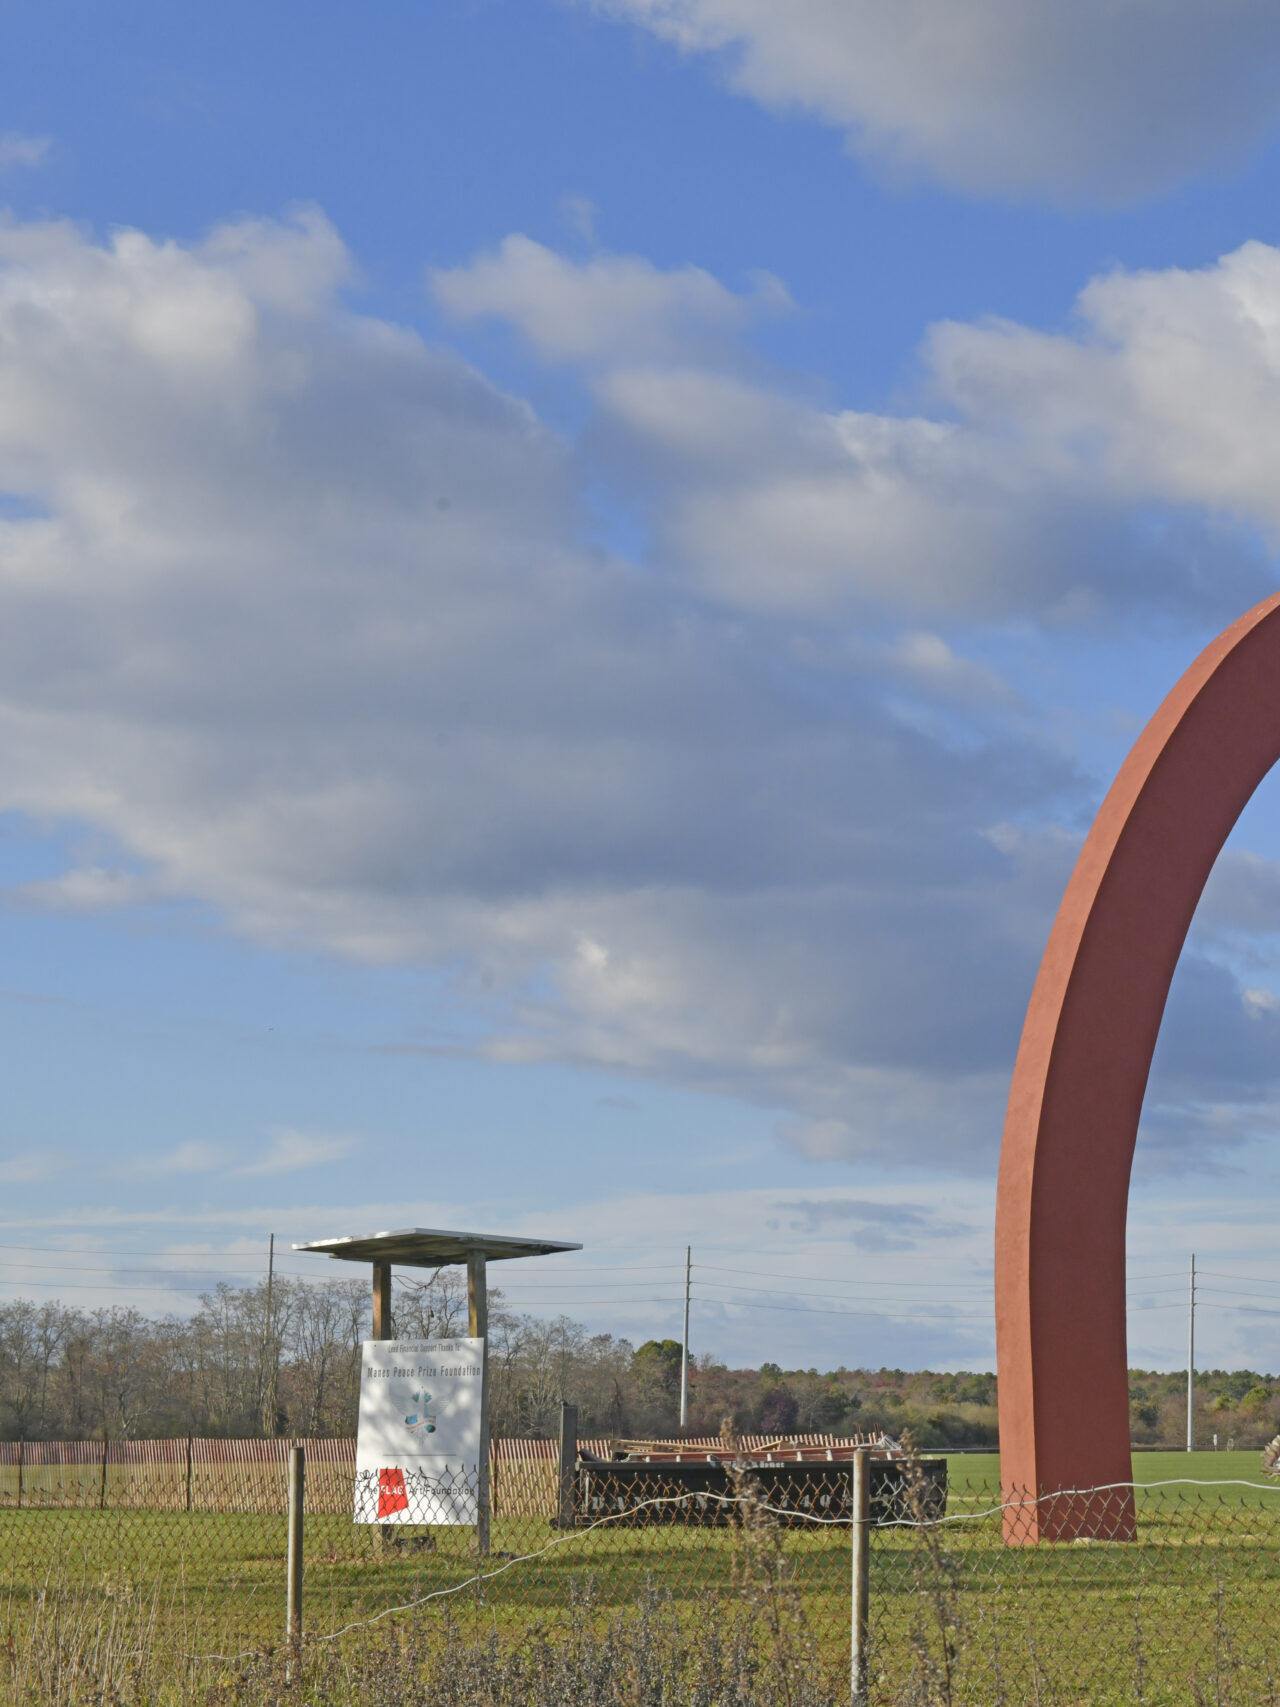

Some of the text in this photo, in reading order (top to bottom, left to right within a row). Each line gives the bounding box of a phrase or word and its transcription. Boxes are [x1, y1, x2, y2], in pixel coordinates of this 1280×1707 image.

[393, 1366, 414, 1377] Peace
[418, 1366, 436, 1377] Prize
[440, 1365, 480, 1377] Foundation
[381, 1485, 404, 1495] FLAG
